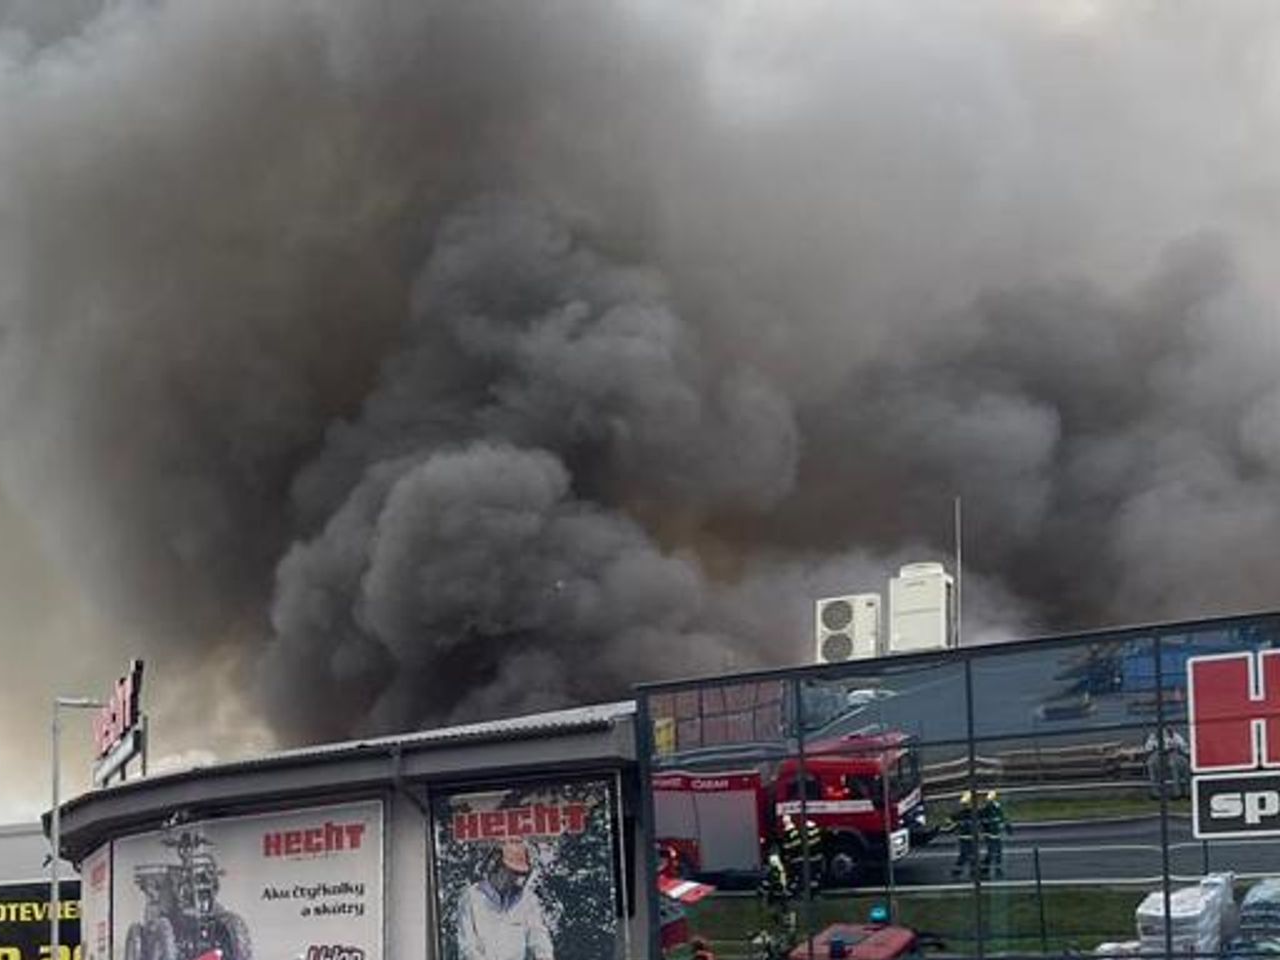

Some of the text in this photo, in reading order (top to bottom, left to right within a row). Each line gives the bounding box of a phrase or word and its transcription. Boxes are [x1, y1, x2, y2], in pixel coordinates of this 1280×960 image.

[1210, 790, 1280, 824] sp
[263, 821, 365, 857] HECHT
[262, 887, 289, 900] Aku
[300, 908, 310, 917] a
